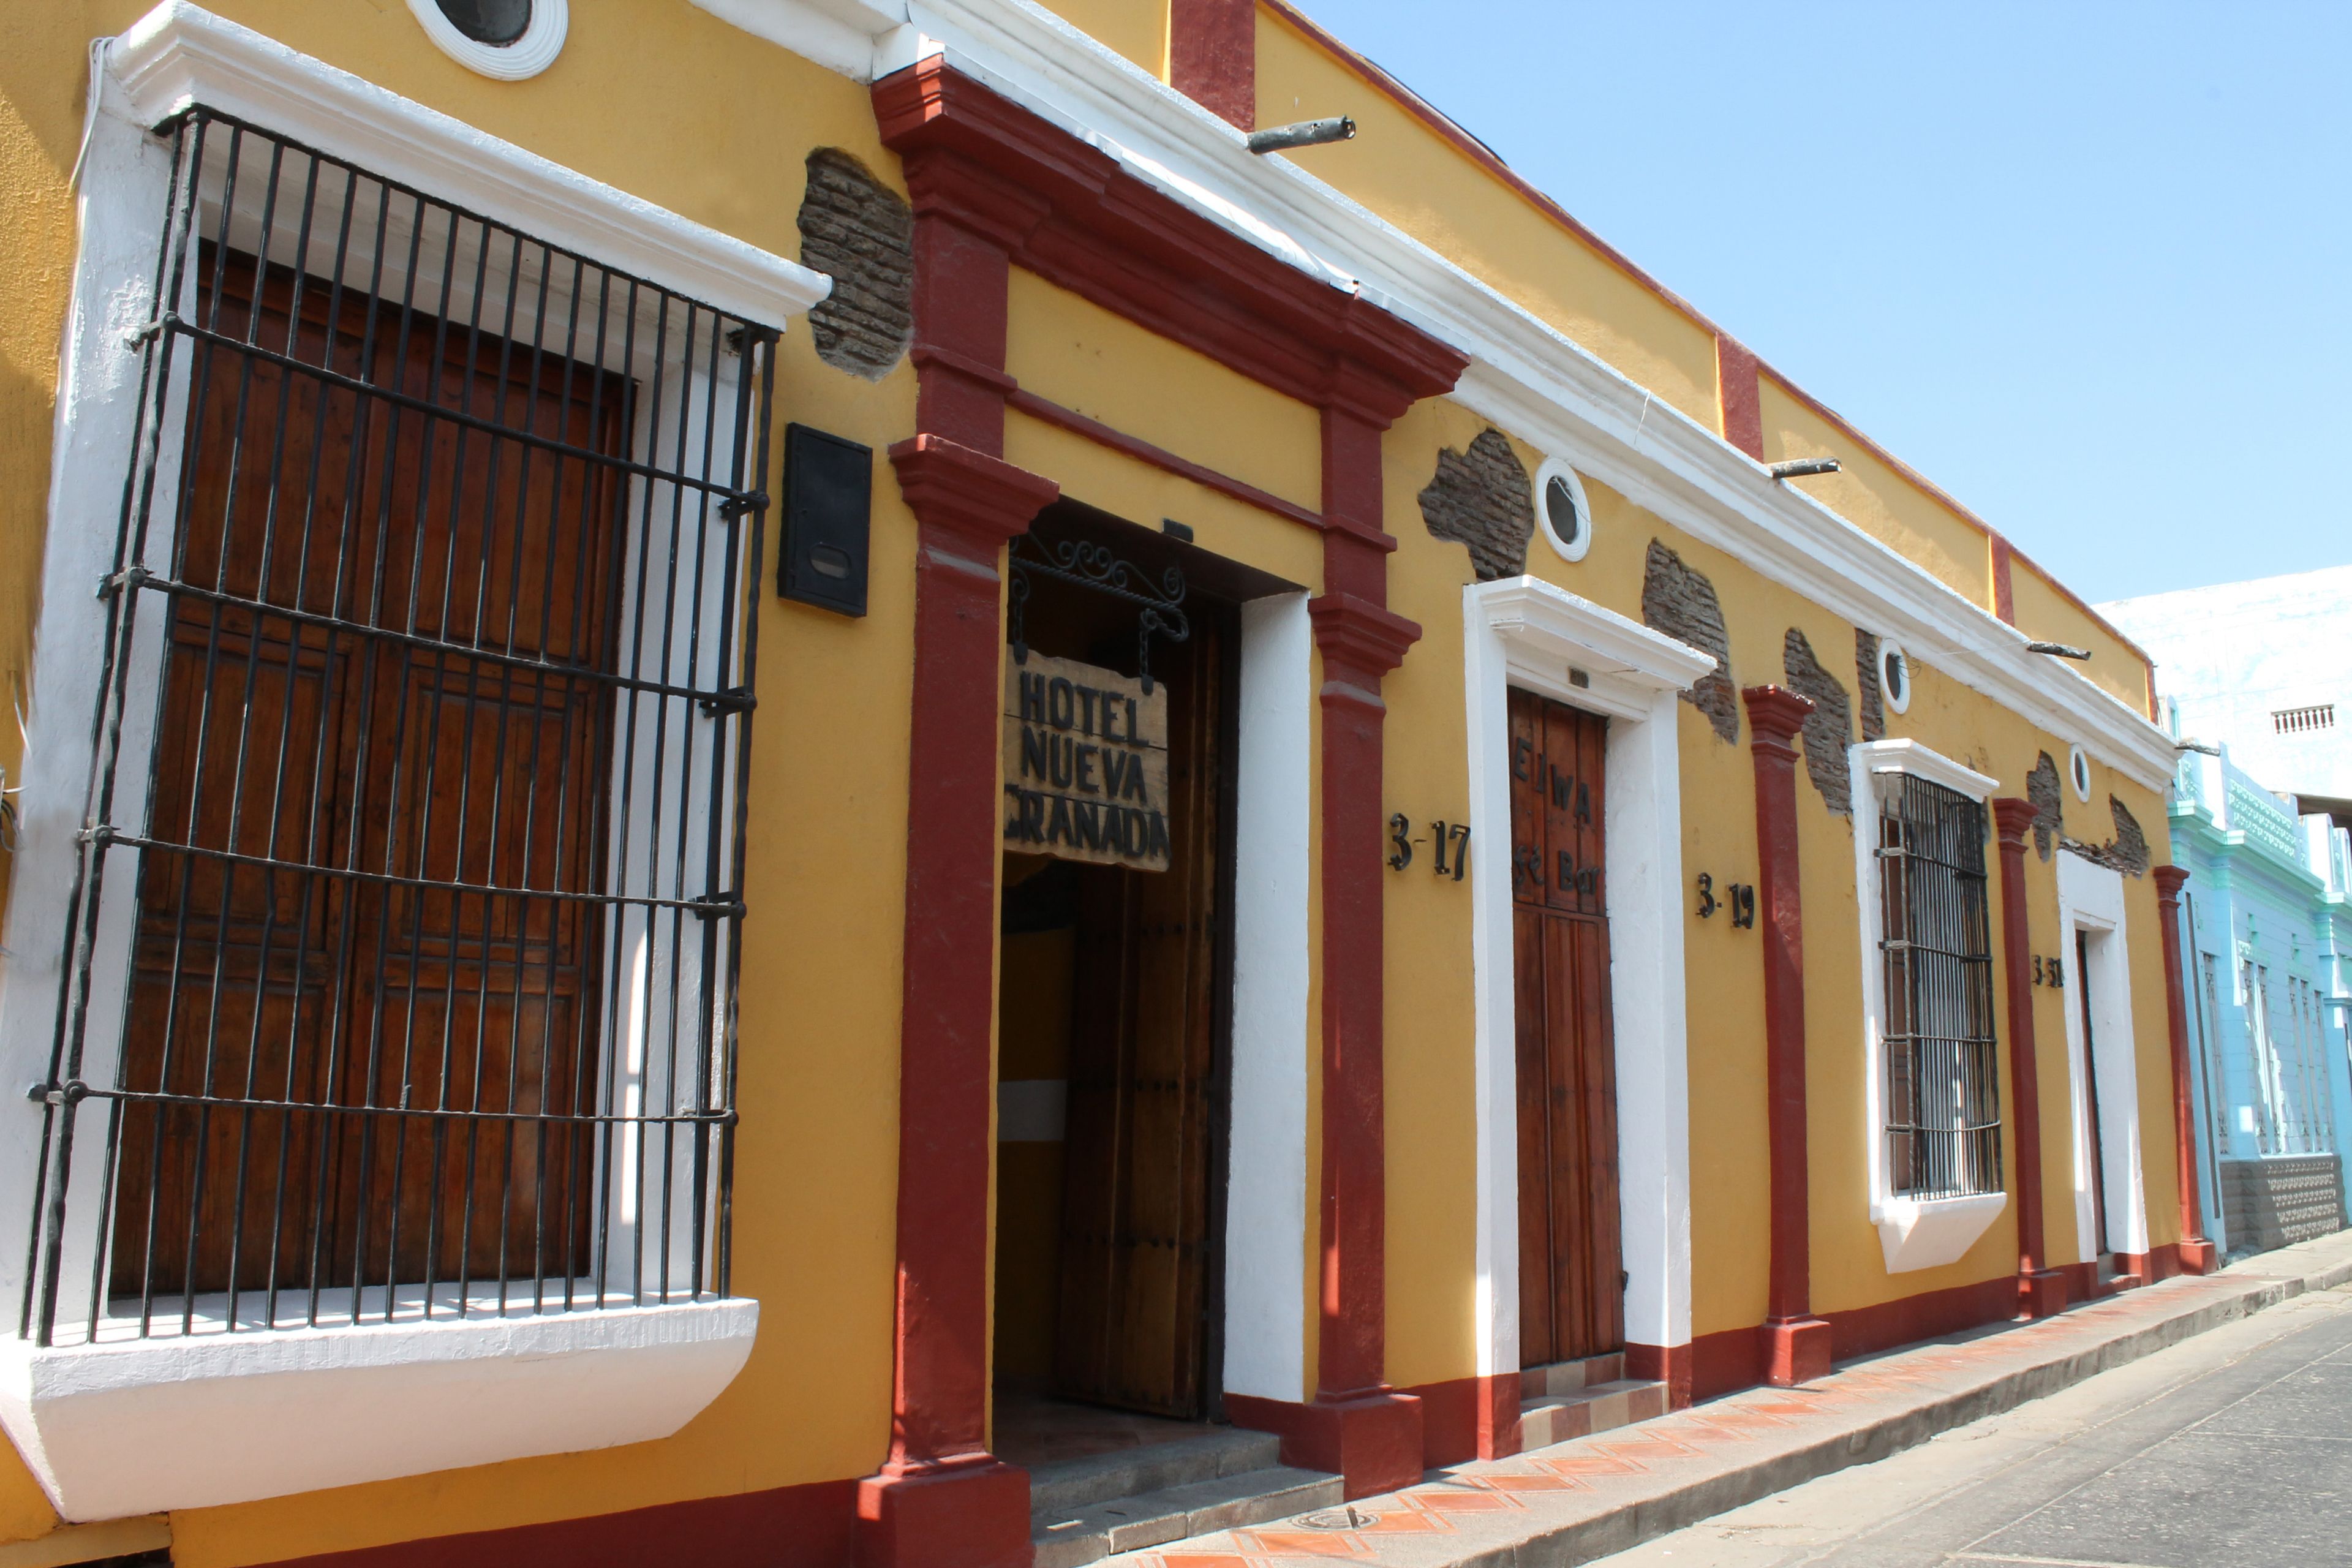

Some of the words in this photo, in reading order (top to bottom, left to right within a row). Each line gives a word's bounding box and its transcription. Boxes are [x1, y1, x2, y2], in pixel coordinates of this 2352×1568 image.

[1021, 672, 1150, 746] HOTEL
[1022, 726, 1147, 803] NUEVA
[1387, 813, 1471, 881] 3-17
[1558, 850, 1600, 895] Bar
